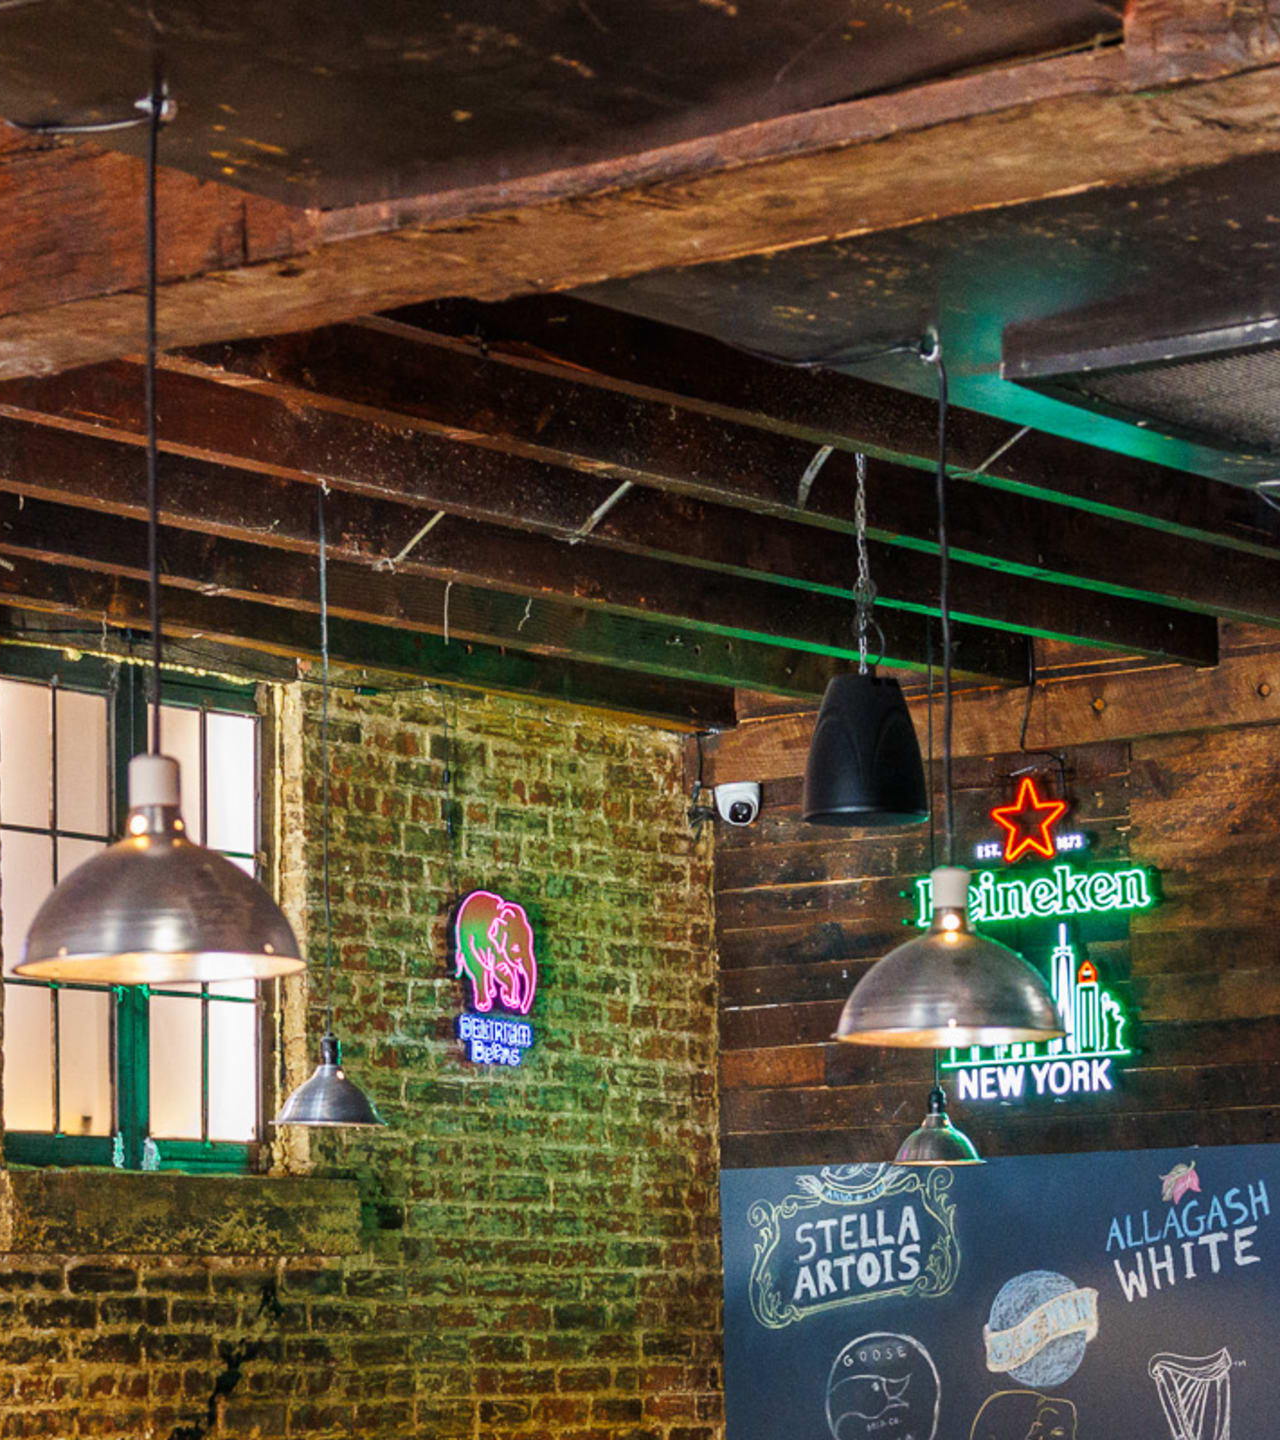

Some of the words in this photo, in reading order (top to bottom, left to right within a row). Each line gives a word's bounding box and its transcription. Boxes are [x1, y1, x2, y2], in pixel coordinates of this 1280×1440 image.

[976, 843, 1002, 859] EST.
[958, 1065, 1025, 1100] NEW
[1031, 1058, 1112, 1095] YORK
[795, 1205, 921, 1261] STELLA
[1105, 1180, 1271, 1252] ALLAGASH
[793, 1244, 921, 1300] ARTOIS
[1114, 1225, 1261, 1302] WHITE
[843, 1346, 907, 1367] GOOSE
